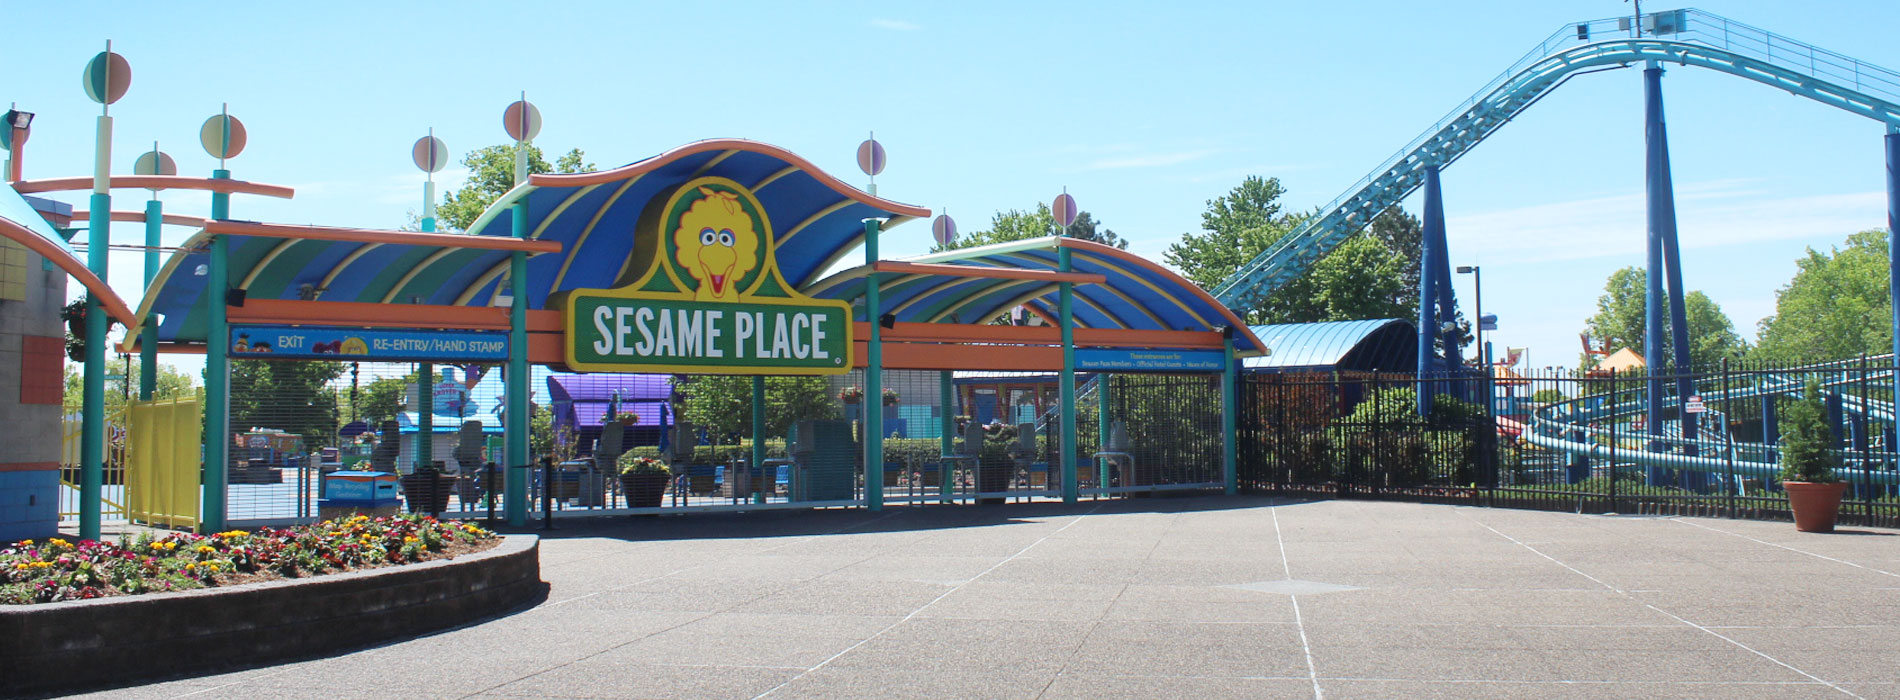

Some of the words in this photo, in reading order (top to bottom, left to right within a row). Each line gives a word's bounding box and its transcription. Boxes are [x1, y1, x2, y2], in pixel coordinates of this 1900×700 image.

[593, 305, 723, 358] SESAME
[735, 311, 829, 359] PLACE
[278, 335, 305, 348] EXIT
[373, 338, 467, 352] RE-ENTRY/HAND
[469, 341, 505, 353] STAMP
